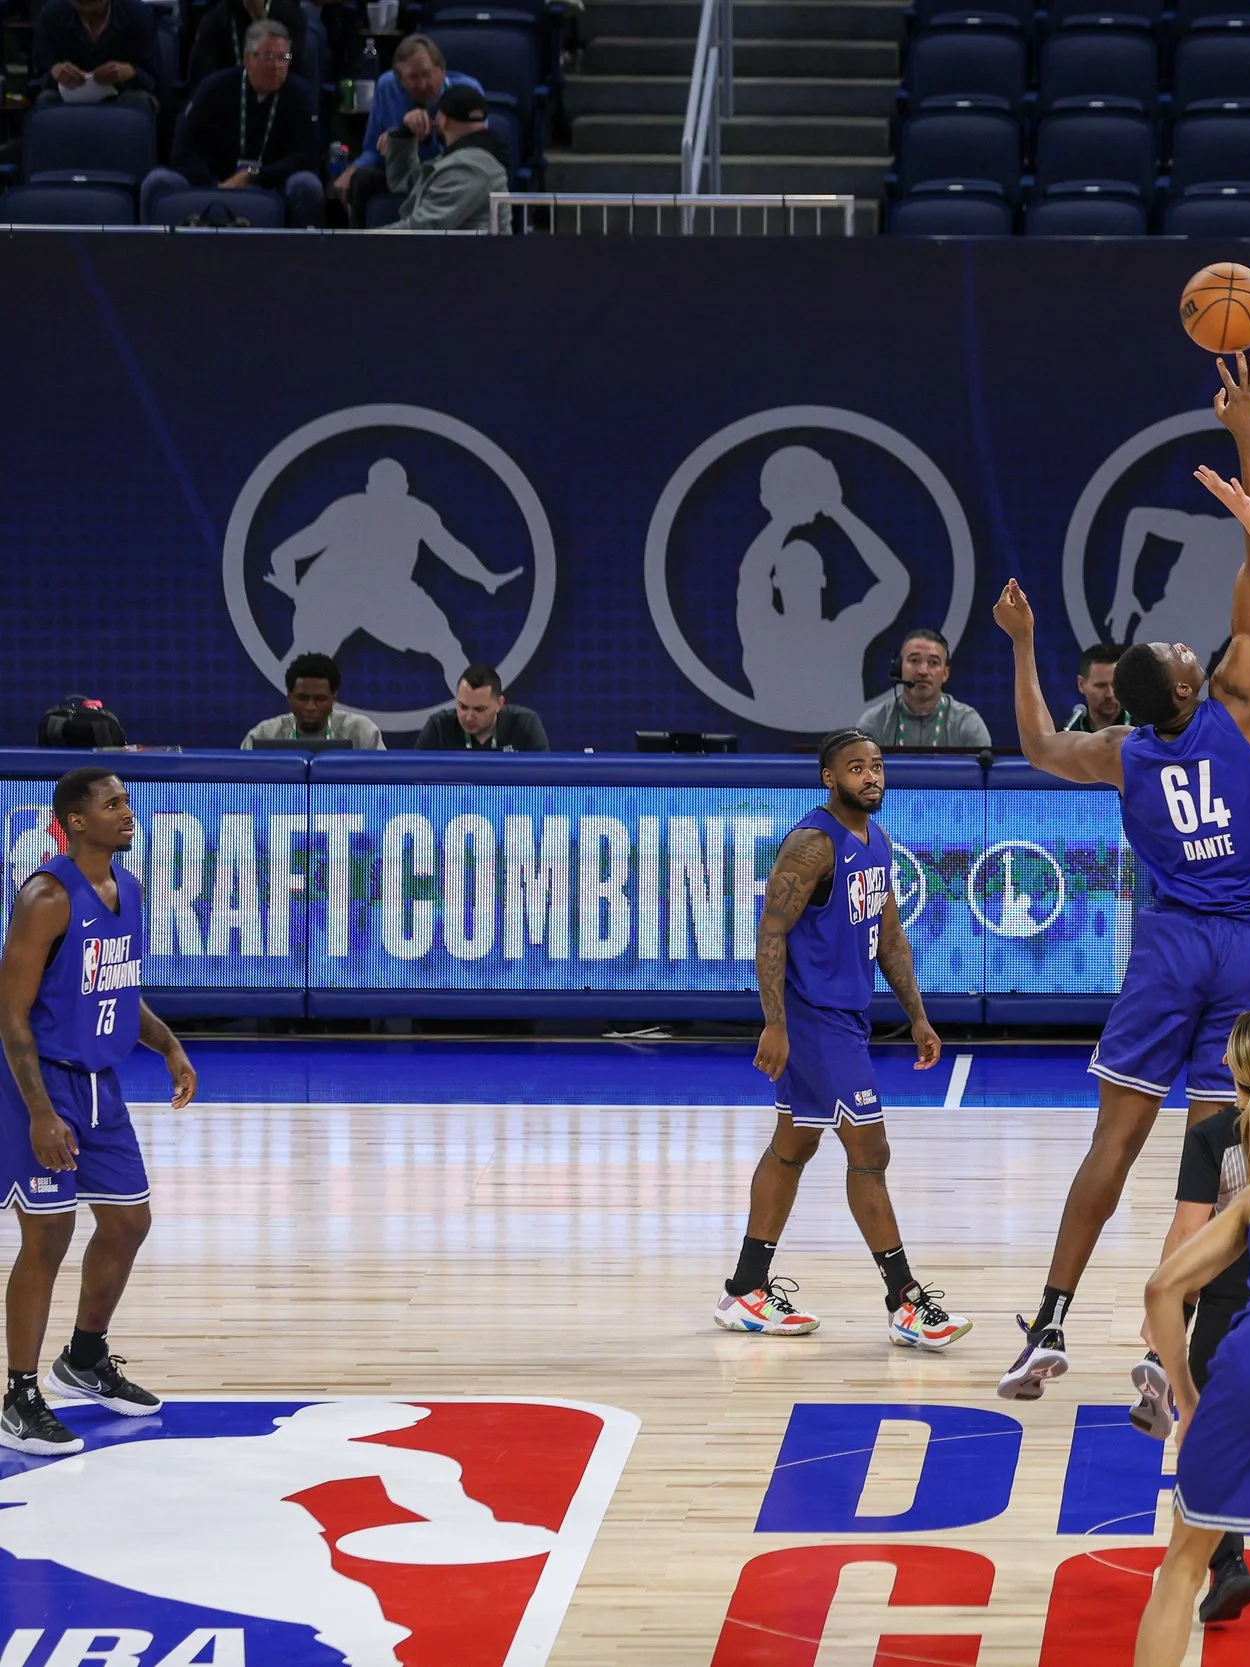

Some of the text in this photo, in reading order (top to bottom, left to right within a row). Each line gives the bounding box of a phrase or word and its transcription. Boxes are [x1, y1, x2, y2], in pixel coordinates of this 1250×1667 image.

[1160, 759, 1232, 834] 64
[1182, 833, 1235, 861] DANTE
[382, 813, 775, 961] COMBINE
[101, 934, 131, 965] DRAFT
[97, 959, 141, 992] COMBINE
[96, 998, 117, 1036] 73
